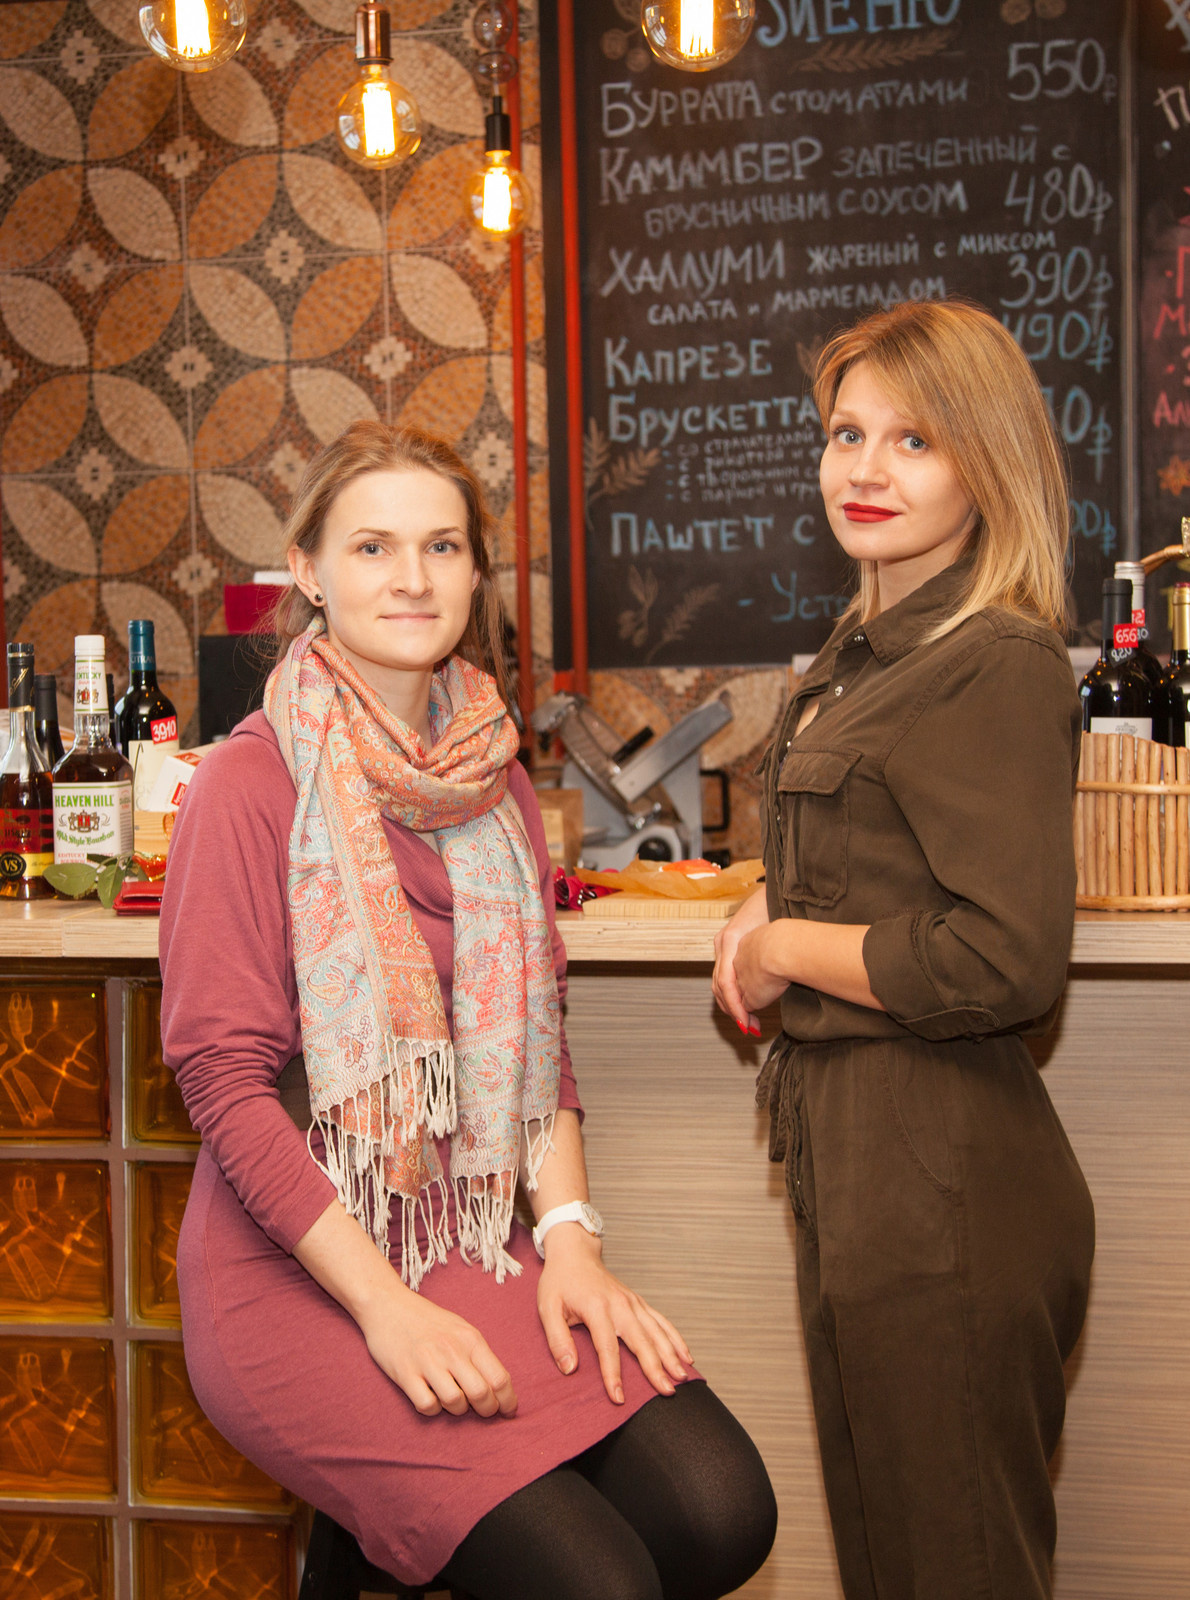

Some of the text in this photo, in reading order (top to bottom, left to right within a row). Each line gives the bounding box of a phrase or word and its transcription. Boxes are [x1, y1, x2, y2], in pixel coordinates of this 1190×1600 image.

[600, 80, 765, 137] БУРРАТА
[600, 136, 822, 205] КАМАМБЕР
[600, 239, 785, 298] ХАЛЛУМИ
[807, 233, 920, 275] ЖАРЕНЫЙ
[957, 231, 1057, 255] МИКСОМ
[648, 298, 738, 326] САЛАТА
[605, 336, 773, 388] КАПРЕЗЕ
[609, 390, 820, 447] БРУСКЕТТА
[611, 512, 775, 556] ПАШТЕТ
[1115, 628, 1137, 644] 656
[153, 719, 177, 743] 3910
[54, 794, 114, 807] HEAVEN HILL
[4, 860, 18, 872] VS
